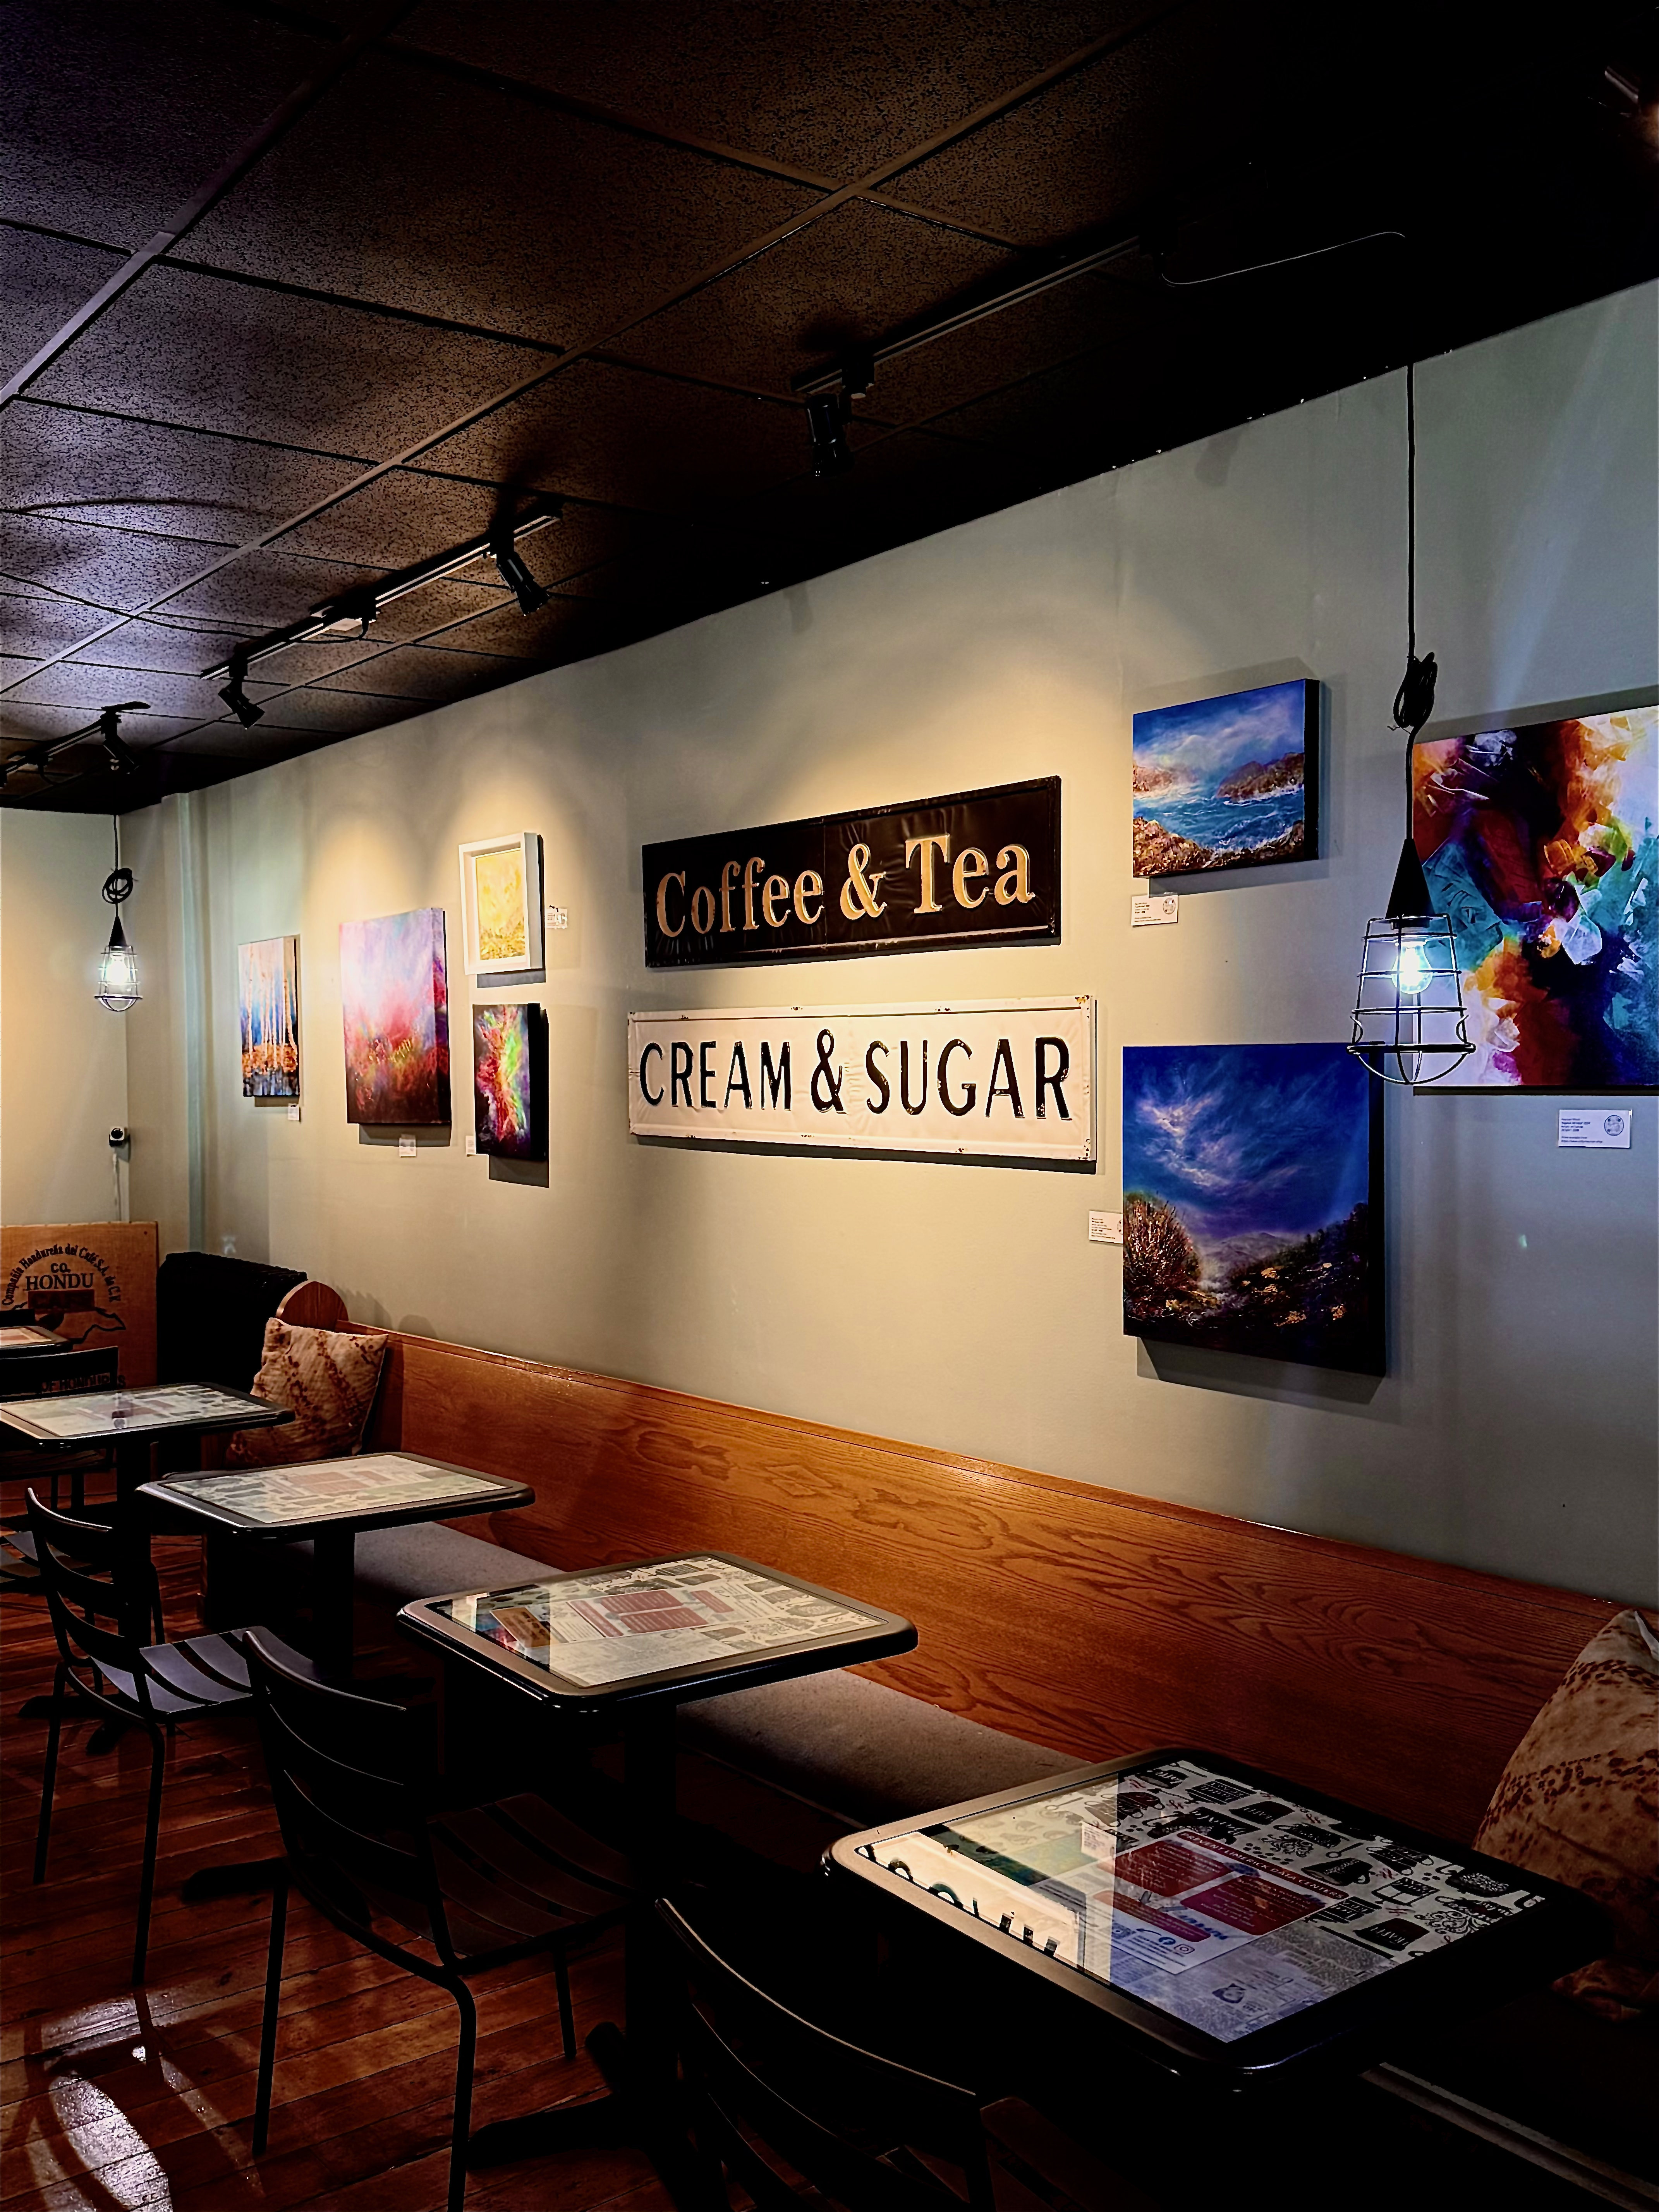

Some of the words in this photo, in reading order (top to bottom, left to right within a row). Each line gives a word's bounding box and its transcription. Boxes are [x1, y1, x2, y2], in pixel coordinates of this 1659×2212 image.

[656, 857, 824, 937] Coffee
[840, 843, 887, 920] &
[905, 833, 1036, 914] Tea
[640, 1041, 791, 1111] CREAM
[811, 1029, 847, 1114] &
[866, 1037, 1072, 1120] SUGAR
[26, 1273, 94, 1291] HONDU
[1180, 1833, 1225, 1850] PREVENT
[1224, 1850, 1269, 1869] LIMERICK
[1270, 1868, 1297, 1880] DATA
[1298, 1879, 1344, 1898] CENTERS
